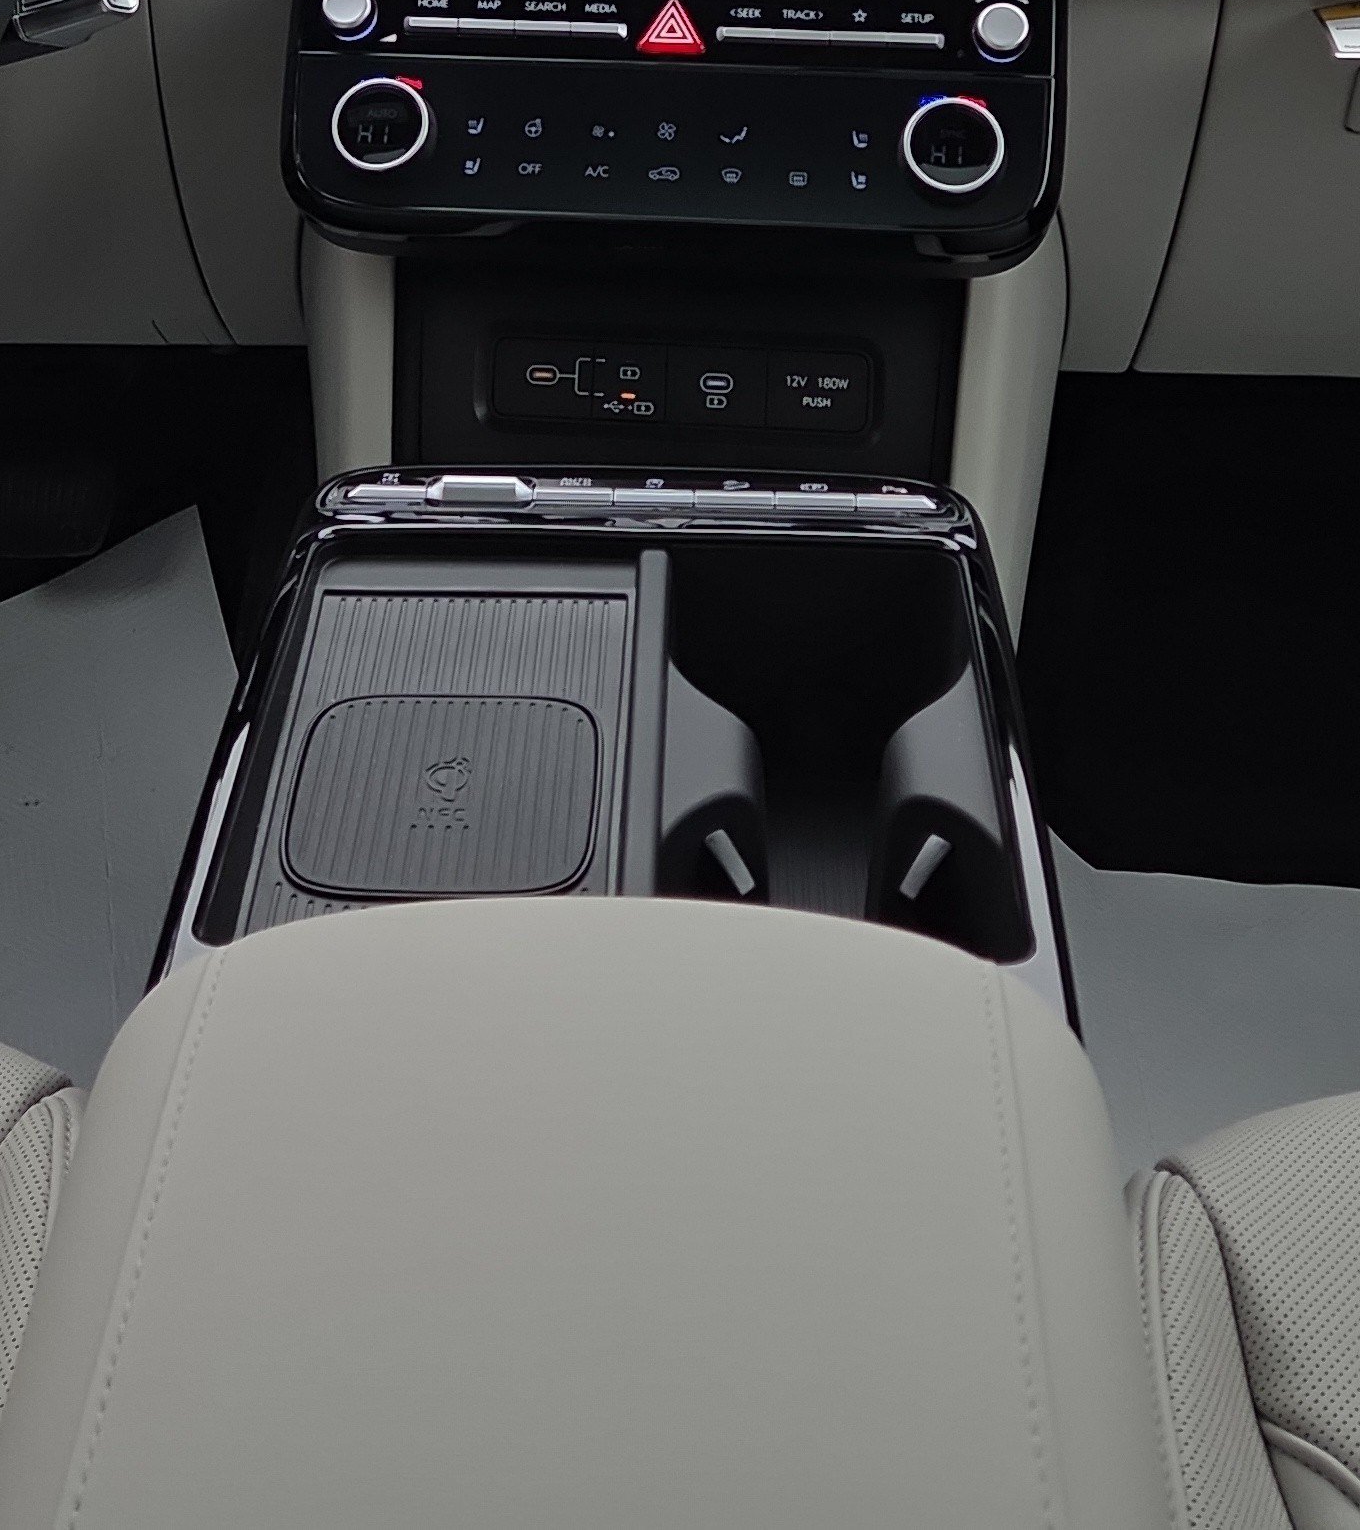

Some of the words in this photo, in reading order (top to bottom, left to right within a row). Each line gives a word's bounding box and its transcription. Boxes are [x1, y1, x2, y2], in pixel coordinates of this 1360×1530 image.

[478, 0, 501, 10] MAP
[525, 1, 566, 12] SEARCH
[585, 3, 617, 14] MEDIA
[737, 7, 761, 19] SEEK
[782, 8, 816, 20] TRACK
[901, 12, 935, 24] SETUP
[518, 162, 543, 175] OFF
[584, 164, 609, 178] A/C
[786, 375, 808, 388] 12V
[818, 376, 849, 390] 180W
[802, 396, 832, 408] PUSH
[418, 807, 466, 822] NFC
